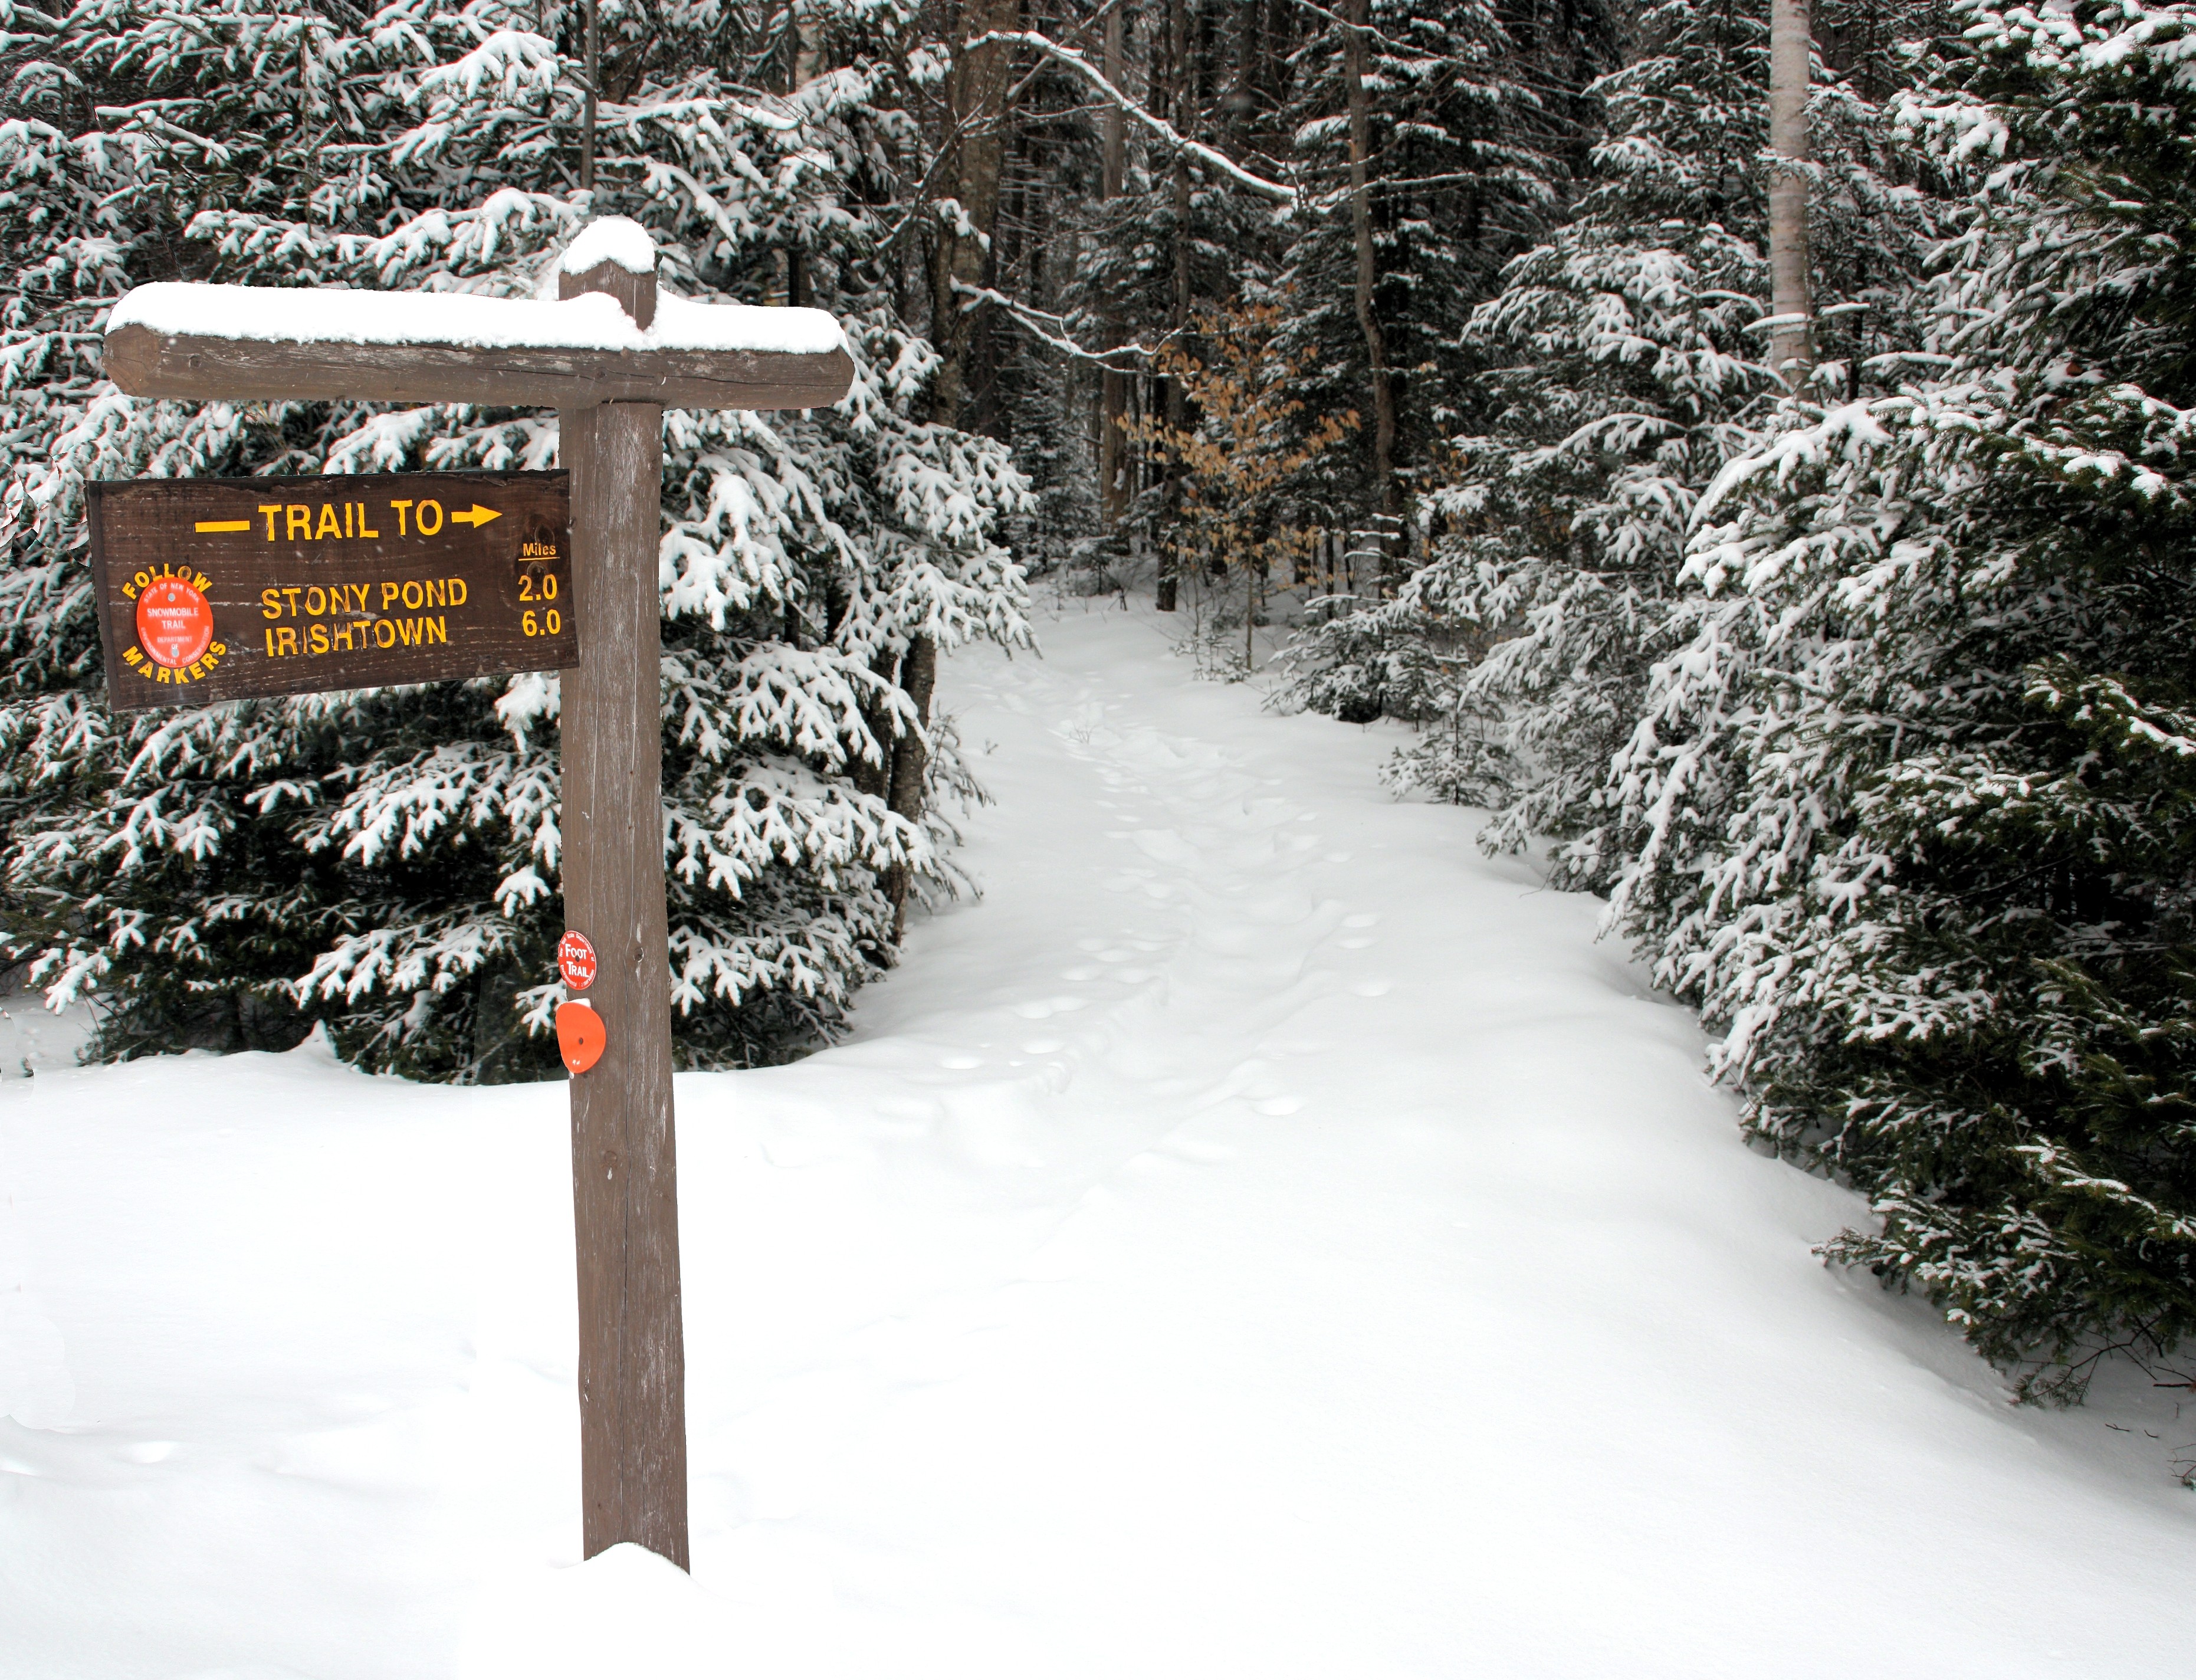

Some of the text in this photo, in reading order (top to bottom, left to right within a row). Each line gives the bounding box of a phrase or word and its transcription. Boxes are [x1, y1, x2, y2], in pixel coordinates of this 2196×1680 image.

[258, 499, 443, 542] TRAIL TO
[523, 542, 556, 556] Miles
[122, 563, 212, 599] FOLLOW
[143, 586, 158, 603] STATE
[170, 582, 184, 591] NEW
[186, 587, 200, 603] YORK
[262, 574, 557, 619] STONY POND 2.0
[147, 607, 199, 617] SNOWMOBILE
[161, 620, 186, 629] TRAIL
[265, 609, 562, 657] IRISHTOWN 6.0
[122, 641, 227, 684] MARKERS
